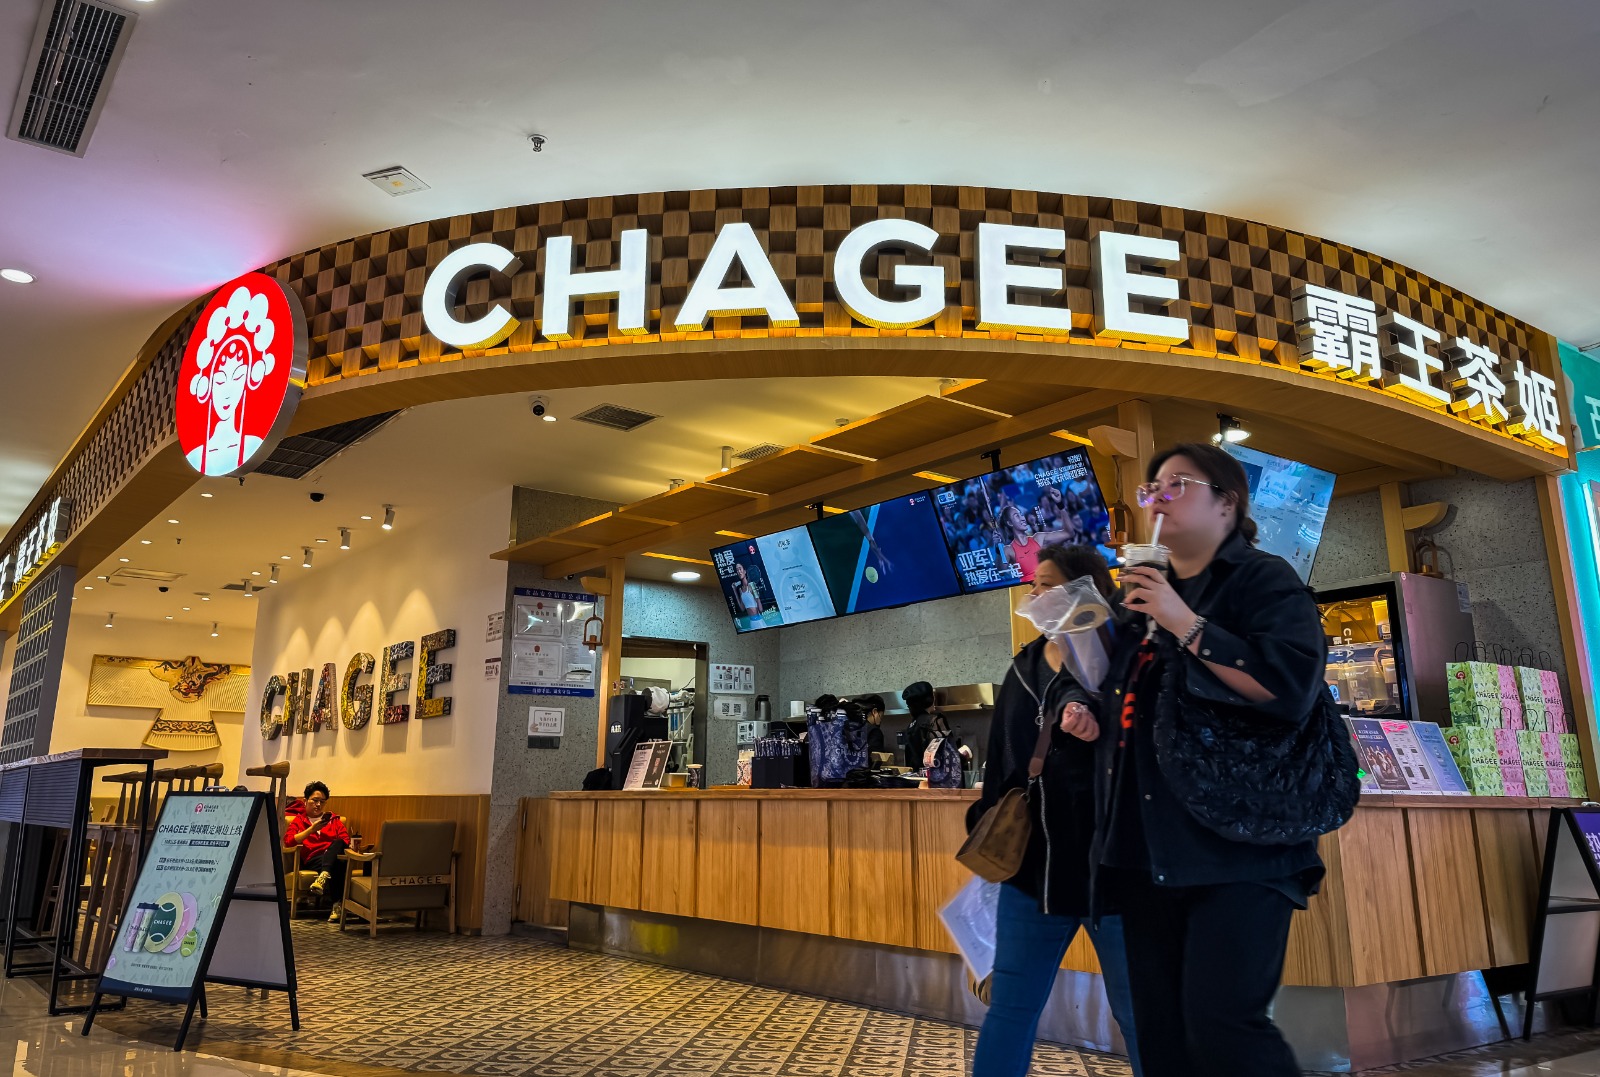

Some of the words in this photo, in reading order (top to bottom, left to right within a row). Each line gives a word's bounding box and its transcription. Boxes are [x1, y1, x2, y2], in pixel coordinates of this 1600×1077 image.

[422, 218, 1189, 348] CHAGEE
[1305, 283, 1566, 446] 霸王茶姬
[1034, 469, 1058, 480] CHAGEE
[714, 549, 736, 569] 热爱
[958, 547, 995, 571] 亚军!
[965, 563, 1024, 586] 热爱在一起
[260, 628, 456, 740] CHAGEE
[1475, 691, 1498, 699] CHAGEE
[835, 748, 867, 758] CHGEE
[1472, 757, 1497, 765] CHAGEE
[1499, 758, 1520, 766] CHAGEE
[1522, 759, 1544, 767] CHAGEE
[1545, 760, 1564, 768] CHAGEE
[158, 824, 189, 834] CHAGEE
[390, 876, 442, 886] CHAGEE
